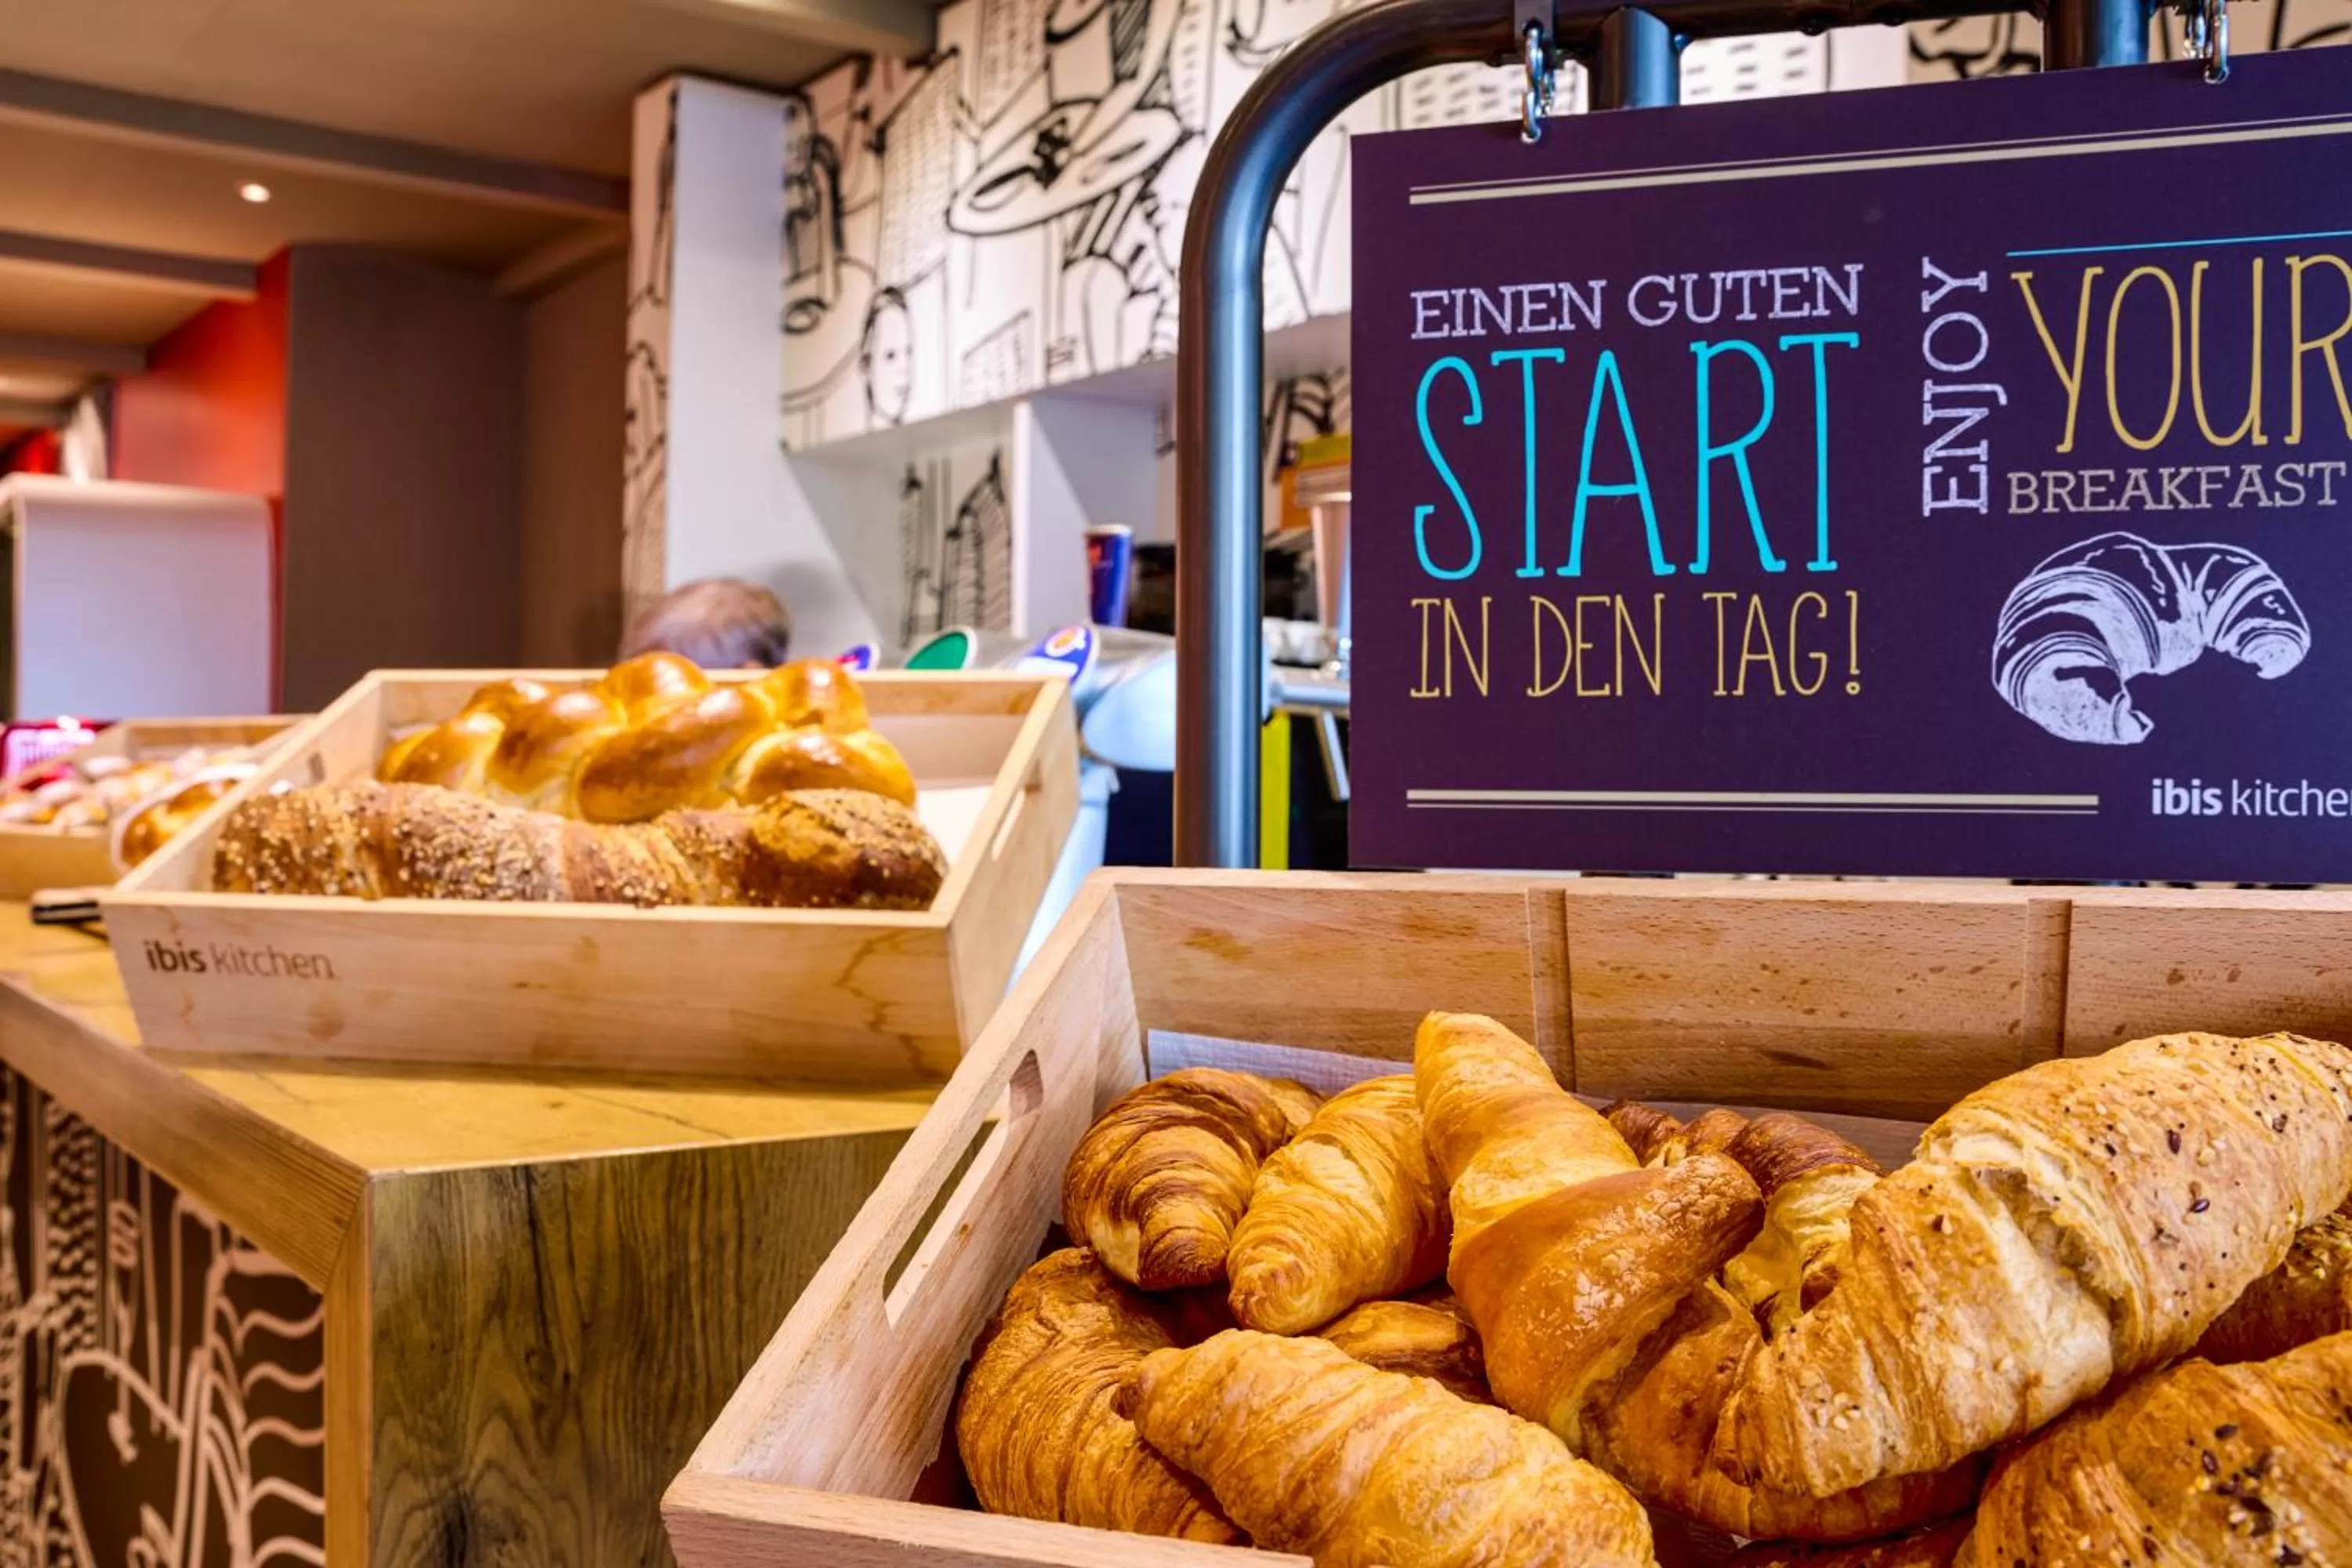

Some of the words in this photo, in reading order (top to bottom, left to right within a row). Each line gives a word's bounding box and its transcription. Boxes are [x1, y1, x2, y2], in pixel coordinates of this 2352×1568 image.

[1410, 278, 1608, 340] EINEN
[1627, 263, 1865, 328] GUTEN
[1921, 256, 2009, 517] ENJOY
[2010, 254, 2352, 454] YOUR
[1414, 332, 1860, 581] START
[2005, 461, 2347, 514] BREAKFAST
[1409, 596, 1493, 699] IN
[1526, 593, 1666, 698] DEN
[1701, 590, 1861, 697] TAG!
[2151, 778, 2223, 817] ibis
[2231, 778, 2352, 818] kitche
[143, 939, 207, 974] ibis
[212, 942, 334, 980] kitchen
